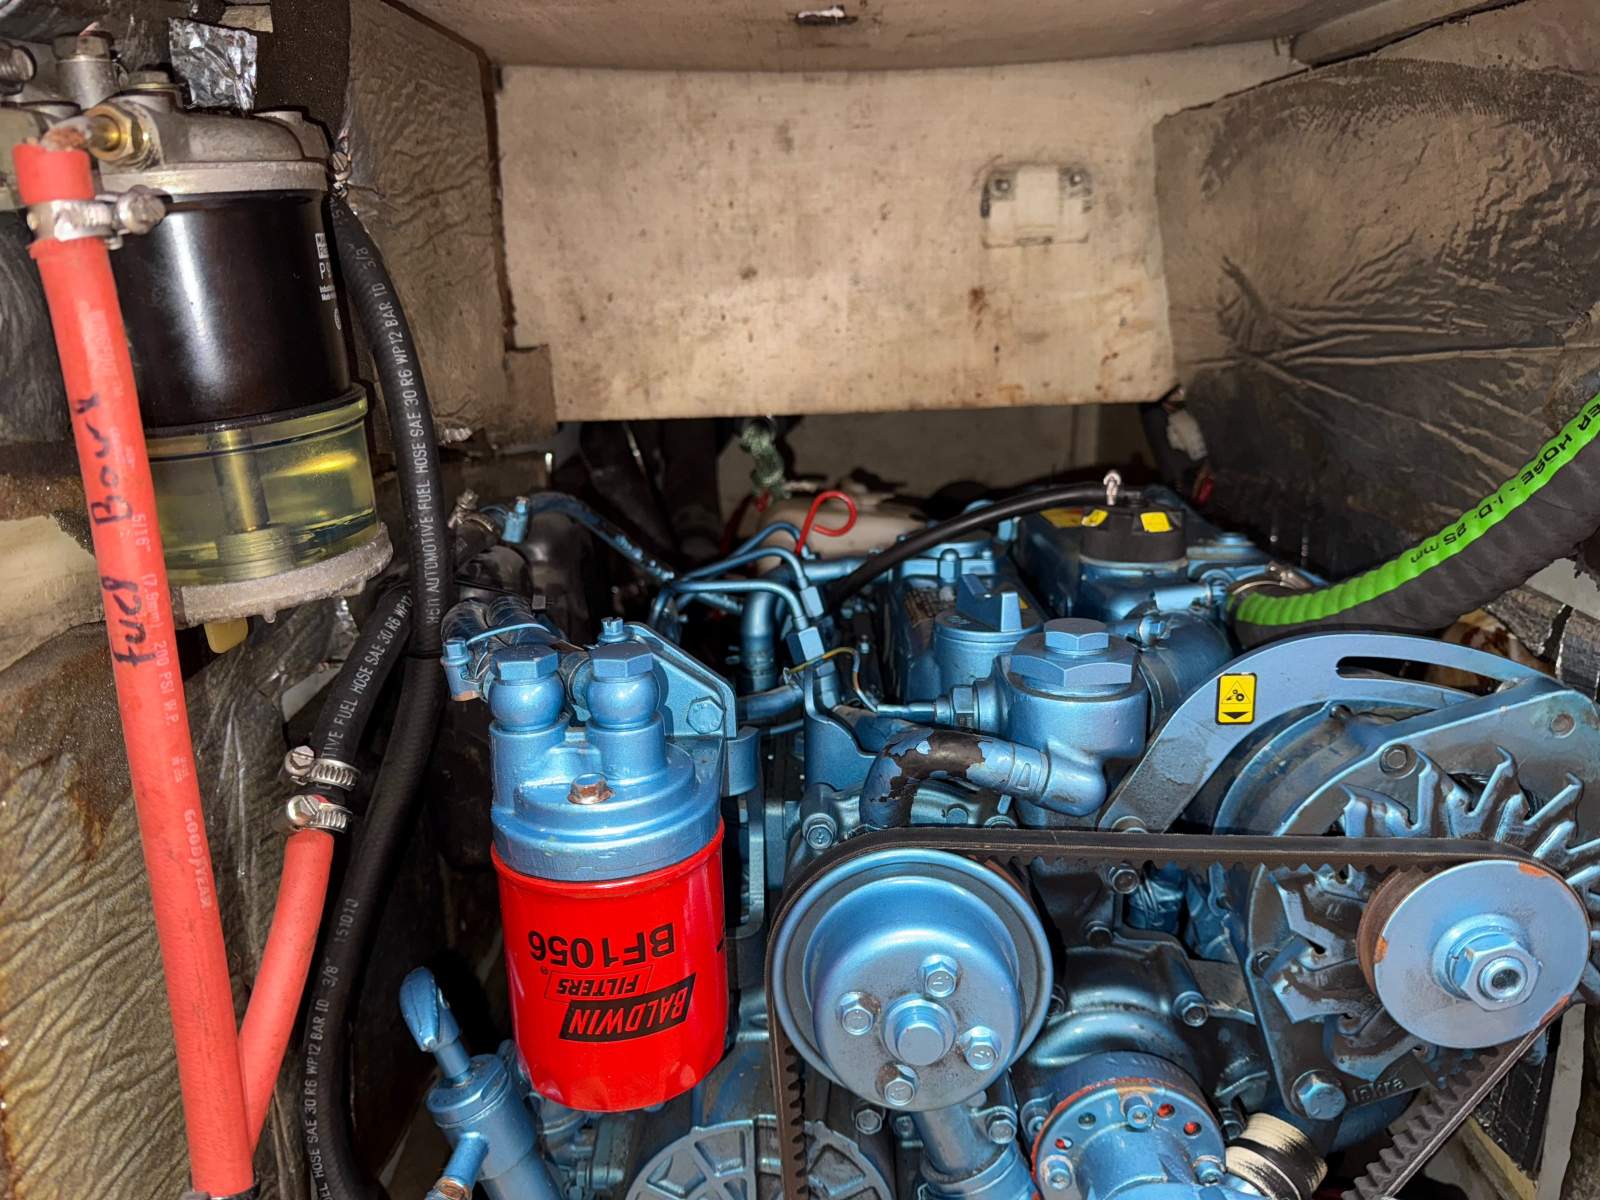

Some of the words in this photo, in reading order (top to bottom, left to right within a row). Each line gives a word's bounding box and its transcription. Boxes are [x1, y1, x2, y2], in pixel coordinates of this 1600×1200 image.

[371, 283, 387, 298] ID
[378, 301, 398, 327] BAR
[388, 331, 408, 365] WP12
[398, 369, 415, 387] R6
[403, 390, 419, 407] 30
[406, 412, 425, 437] SAE
[411, 442, 428, 473] HOSE
[1520, 433, 1573, 485] HOSE
[416, 480, 433, 510] FUEL
[420, 516, 440, 593] AUTOMOTIVE
[385, 616, 401, 631] R6
[379, 629, 393, 644] 30
[153, 640, 169, 666] 200
[364, 645, 385, 665] SAE
[159, 671, 174, 695] PSI
[351, 667, 374, 694] HOSE
[334, 698, 358, 725] FUEL
[528, 922, 675, 969] BF1056
[556, 974, 640, 997] FILTERS
[314, 998, 330, 1013] ID
[567, 986, 688, 1036] BALDWIN
[310, 1016, 326, 1040] BAR
[306, 1045, 321, 1074] WP12
[304, 1080, 318, 1099] R6
[304, 1099, 317, 1115] 30
[305, 1118, 319, 1143] SAE
[310, 1148, 325, 1178] HOSE
